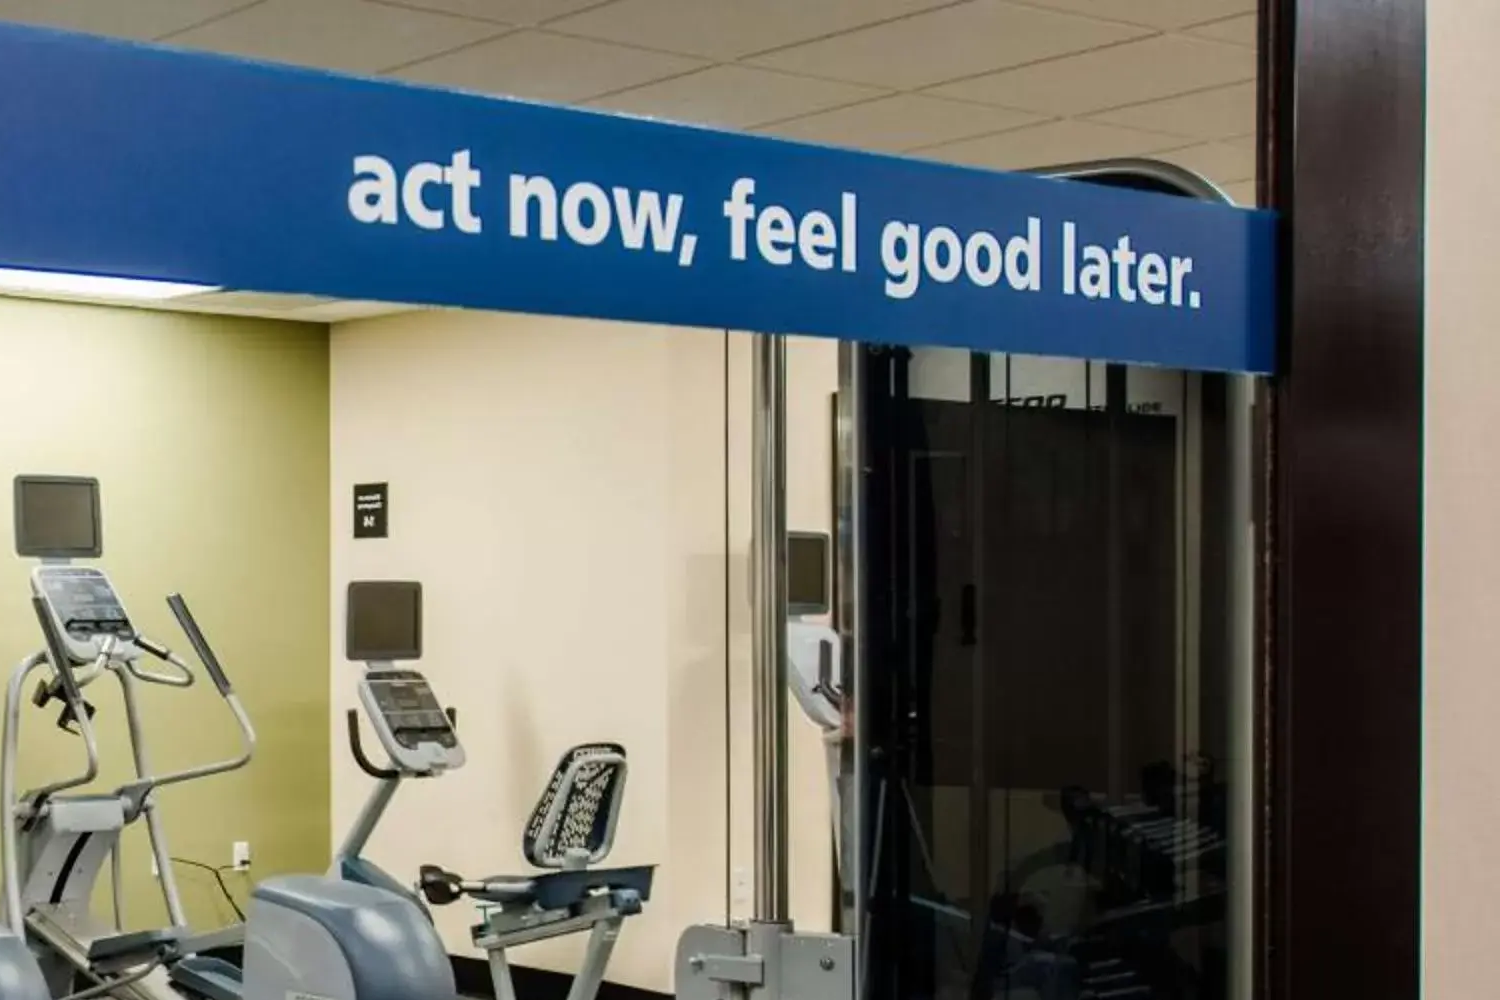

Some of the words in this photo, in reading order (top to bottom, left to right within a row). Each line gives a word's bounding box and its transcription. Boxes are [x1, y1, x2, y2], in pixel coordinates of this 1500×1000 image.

[348, 150, 480, 232] act
[510, 175, 696, 265] now,
[724, 178, 855, 271] feel
[882, 217, 1040, 298] good
[1064, 222, 1200, 307] later.
